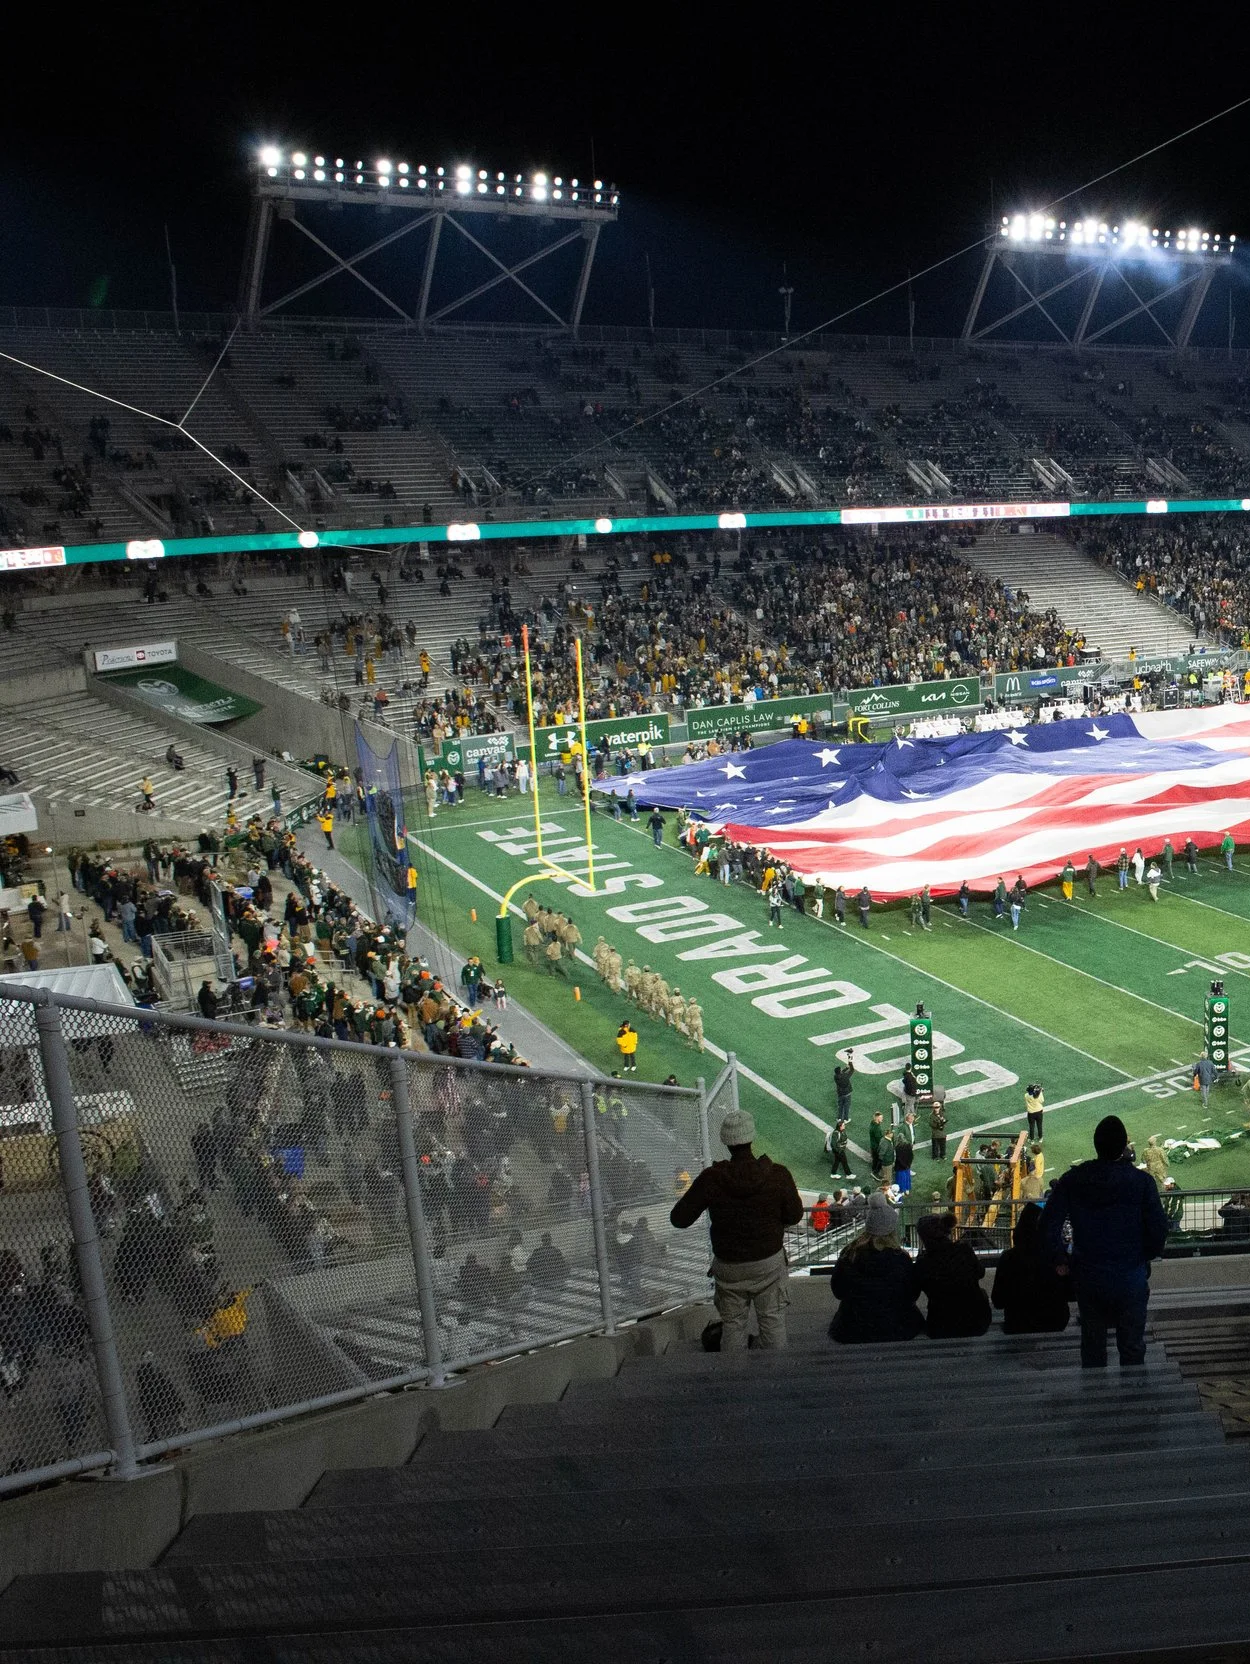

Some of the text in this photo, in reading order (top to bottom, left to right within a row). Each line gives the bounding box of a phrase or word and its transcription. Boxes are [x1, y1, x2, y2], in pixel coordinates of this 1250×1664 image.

[147, 649, 173, 657] TOYOTA
[854, 700, 899, 712] FORT COLLINS
[692, 712, 774, 730] DAN CAPLIS LAW
[466, 746, 506, 758] canvas
[476, 821, 1020, 1104] COLORADO STATE
